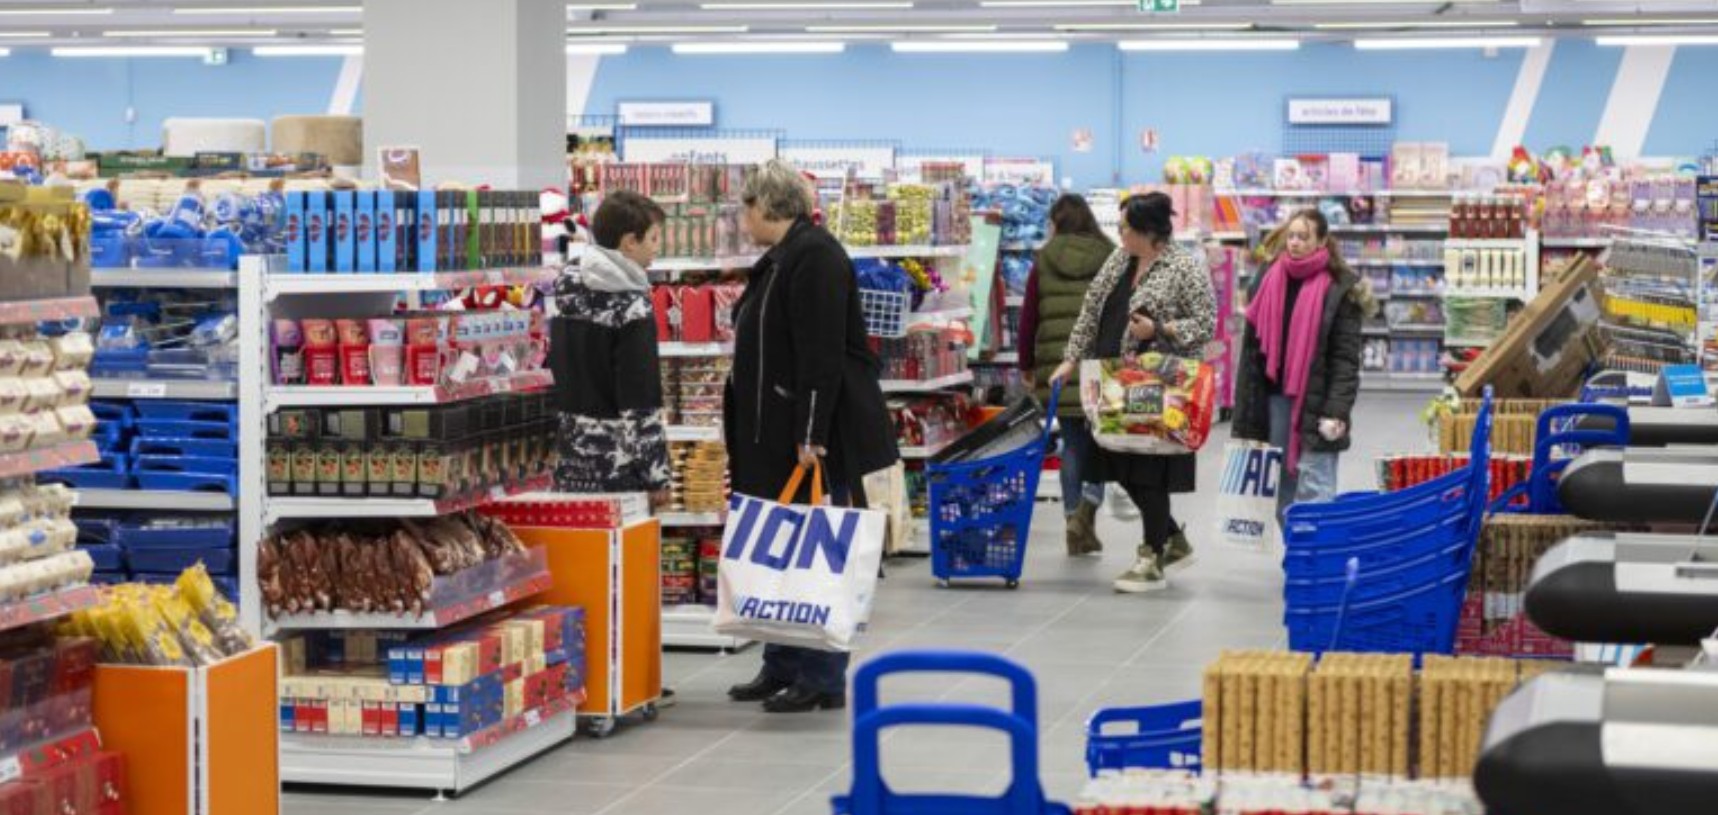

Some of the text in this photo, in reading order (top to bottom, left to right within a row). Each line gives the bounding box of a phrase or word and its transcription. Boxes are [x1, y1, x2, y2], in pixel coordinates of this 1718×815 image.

[792, 157, 865, 169] haussettes
[725, 494, 861, 574] ION
[1228, 518, 1264, 536] ACTION
[740, 597, 831, 625] ACTION
